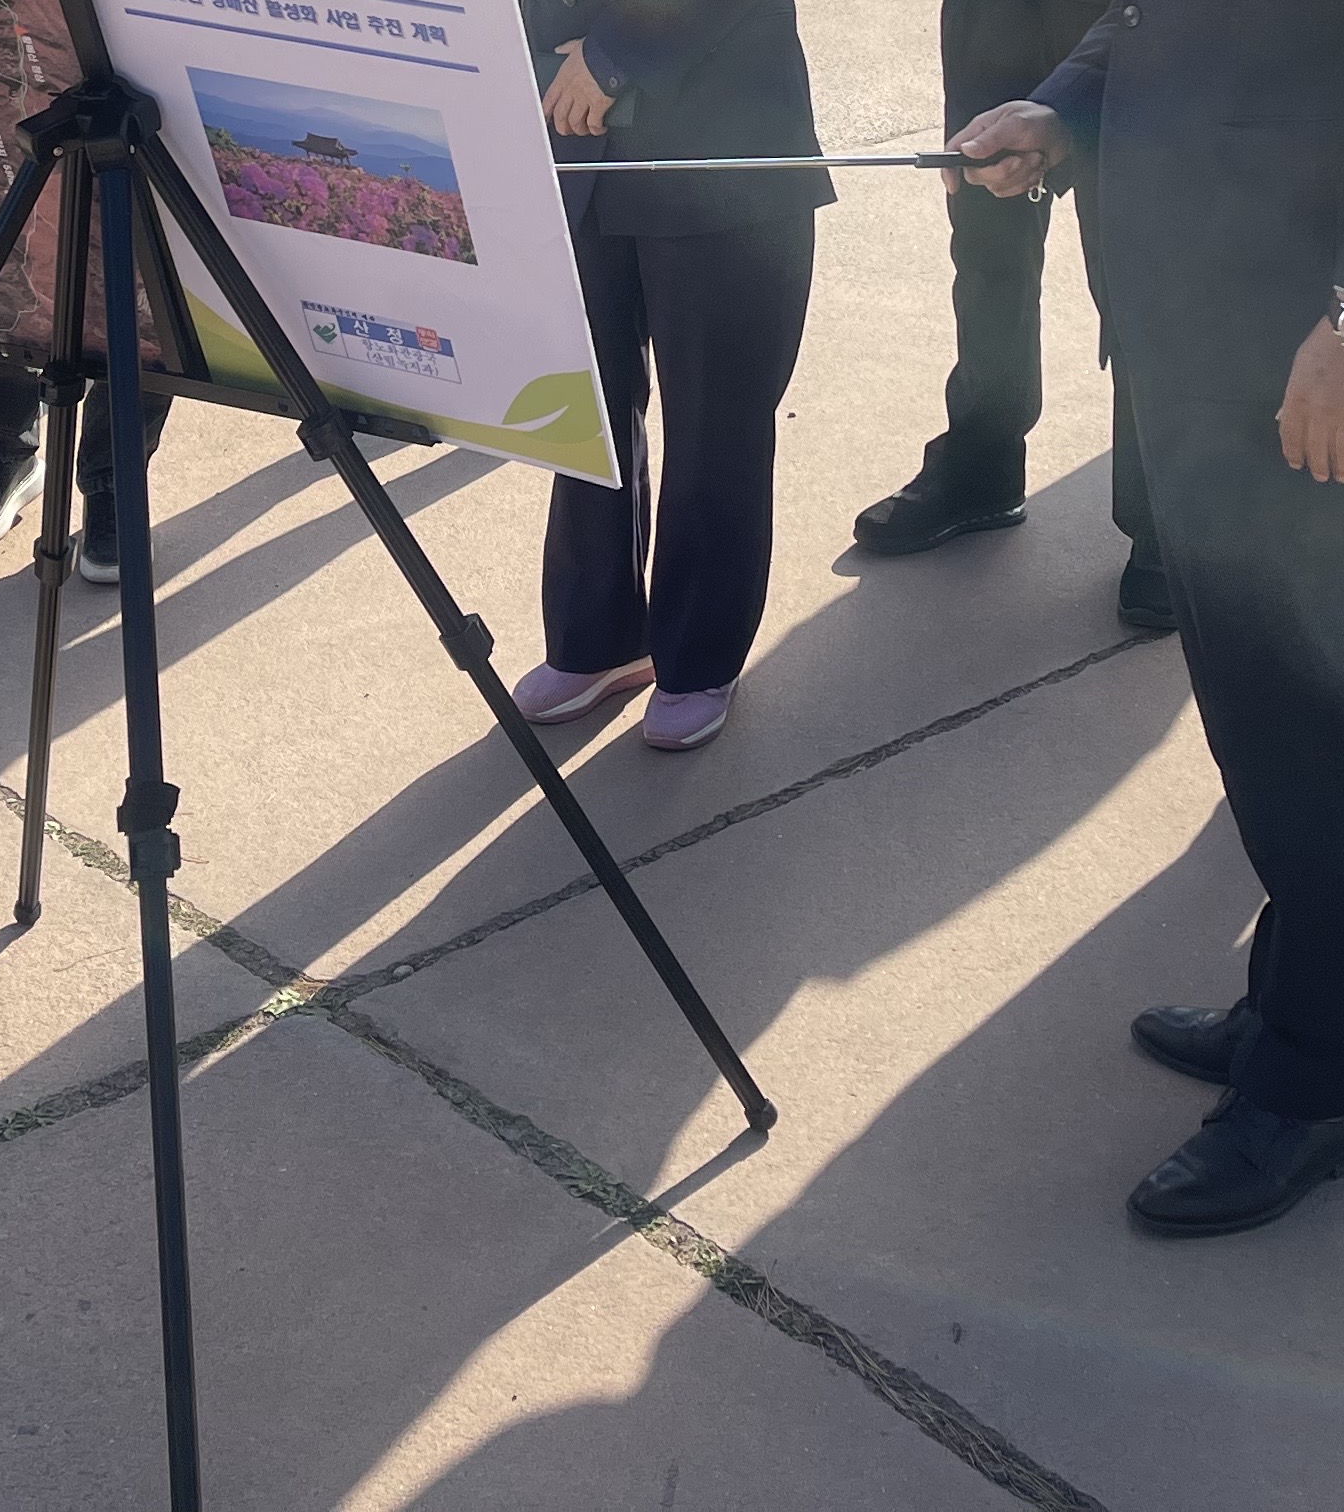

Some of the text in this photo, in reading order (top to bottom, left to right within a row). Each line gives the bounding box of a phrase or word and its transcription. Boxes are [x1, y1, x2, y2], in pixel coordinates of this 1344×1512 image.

[264, 0, 318, 25] 활성화
[327, 8, 362, 32] 사업
[366, 14, 406, 39] 추진
[410, 21, 449, 47] 계획
